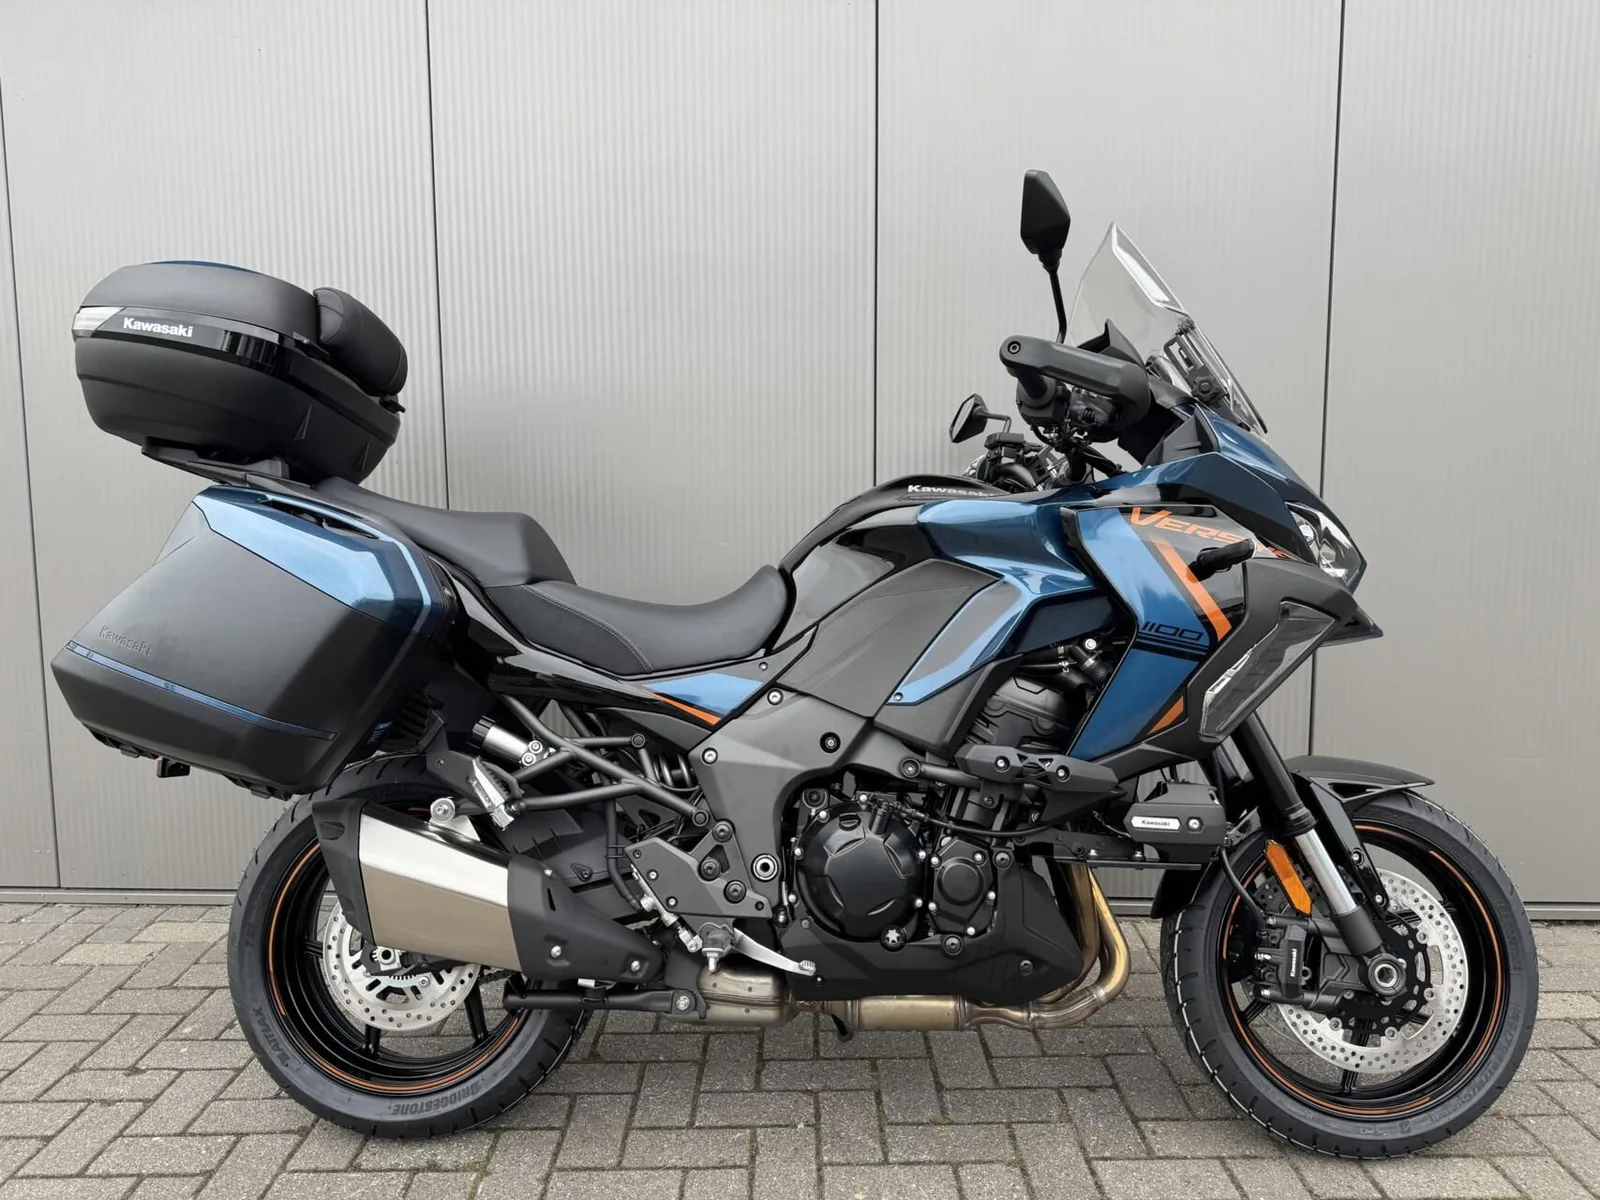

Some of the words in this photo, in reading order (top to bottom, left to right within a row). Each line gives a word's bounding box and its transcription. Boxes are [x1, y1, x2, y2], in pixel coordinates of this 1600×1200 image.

[122, 317, 194, 338] Kawasaki
[98, 625, 152, 656] Kawasaki
[1140, 622, 1203, 642] 1100
[1141, 819, 1170, 827] Kawasaki
[1289, 948, 1298, 977] Kawasaki
[391, 1080, 482, 1116] BRIDGESTONE
